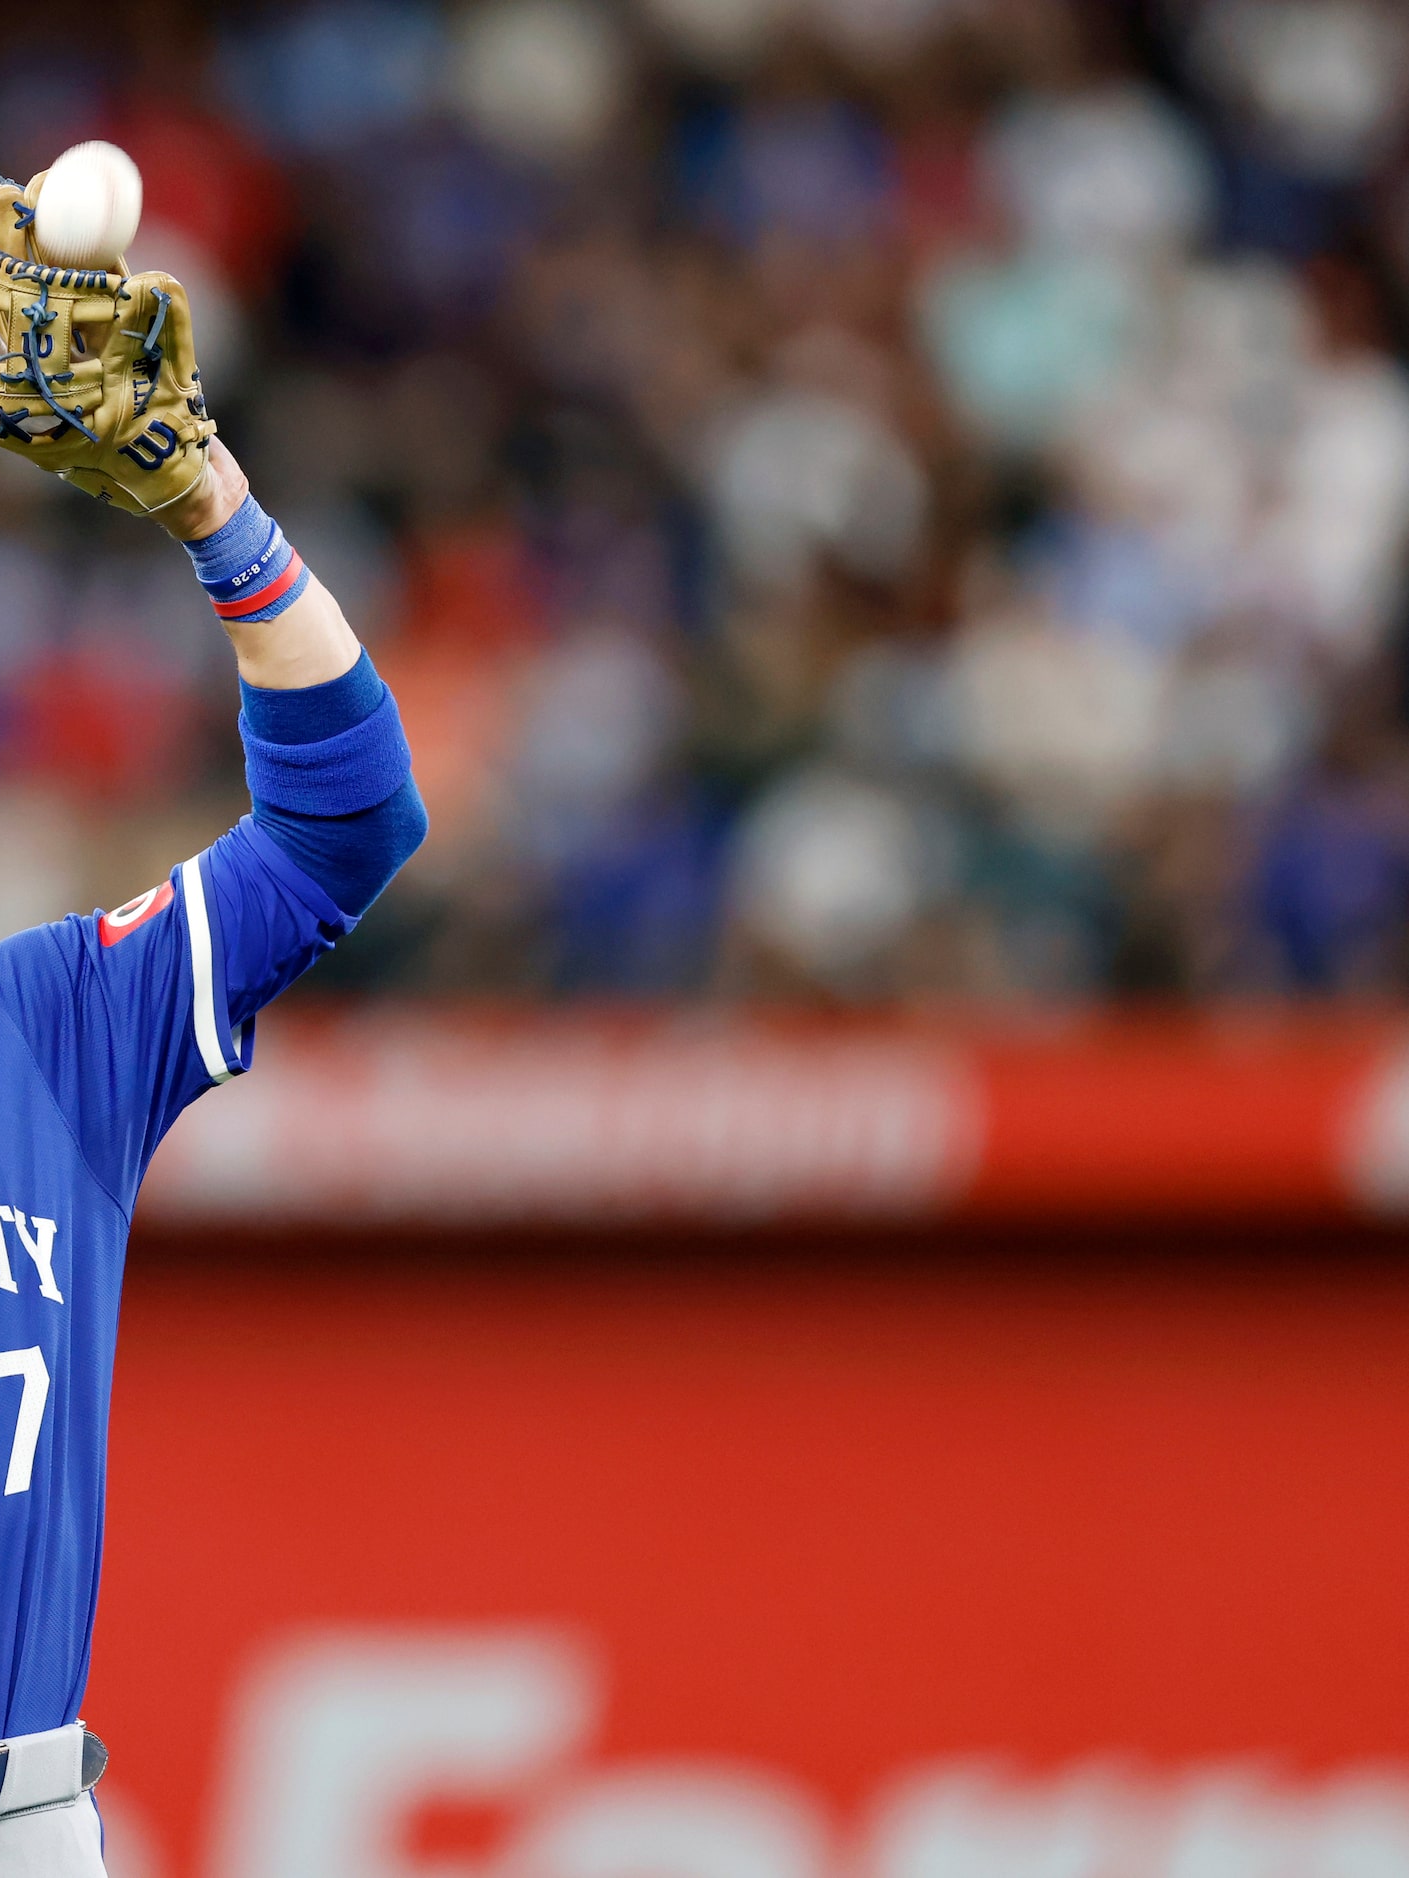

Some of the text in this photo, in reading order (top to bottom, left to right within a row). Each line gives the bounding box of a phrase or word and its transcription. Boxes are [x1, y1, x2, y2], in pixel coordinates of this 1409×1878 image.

[118, 419, 177, 471] W
[232, 533, 281, 586] mans 8:28
